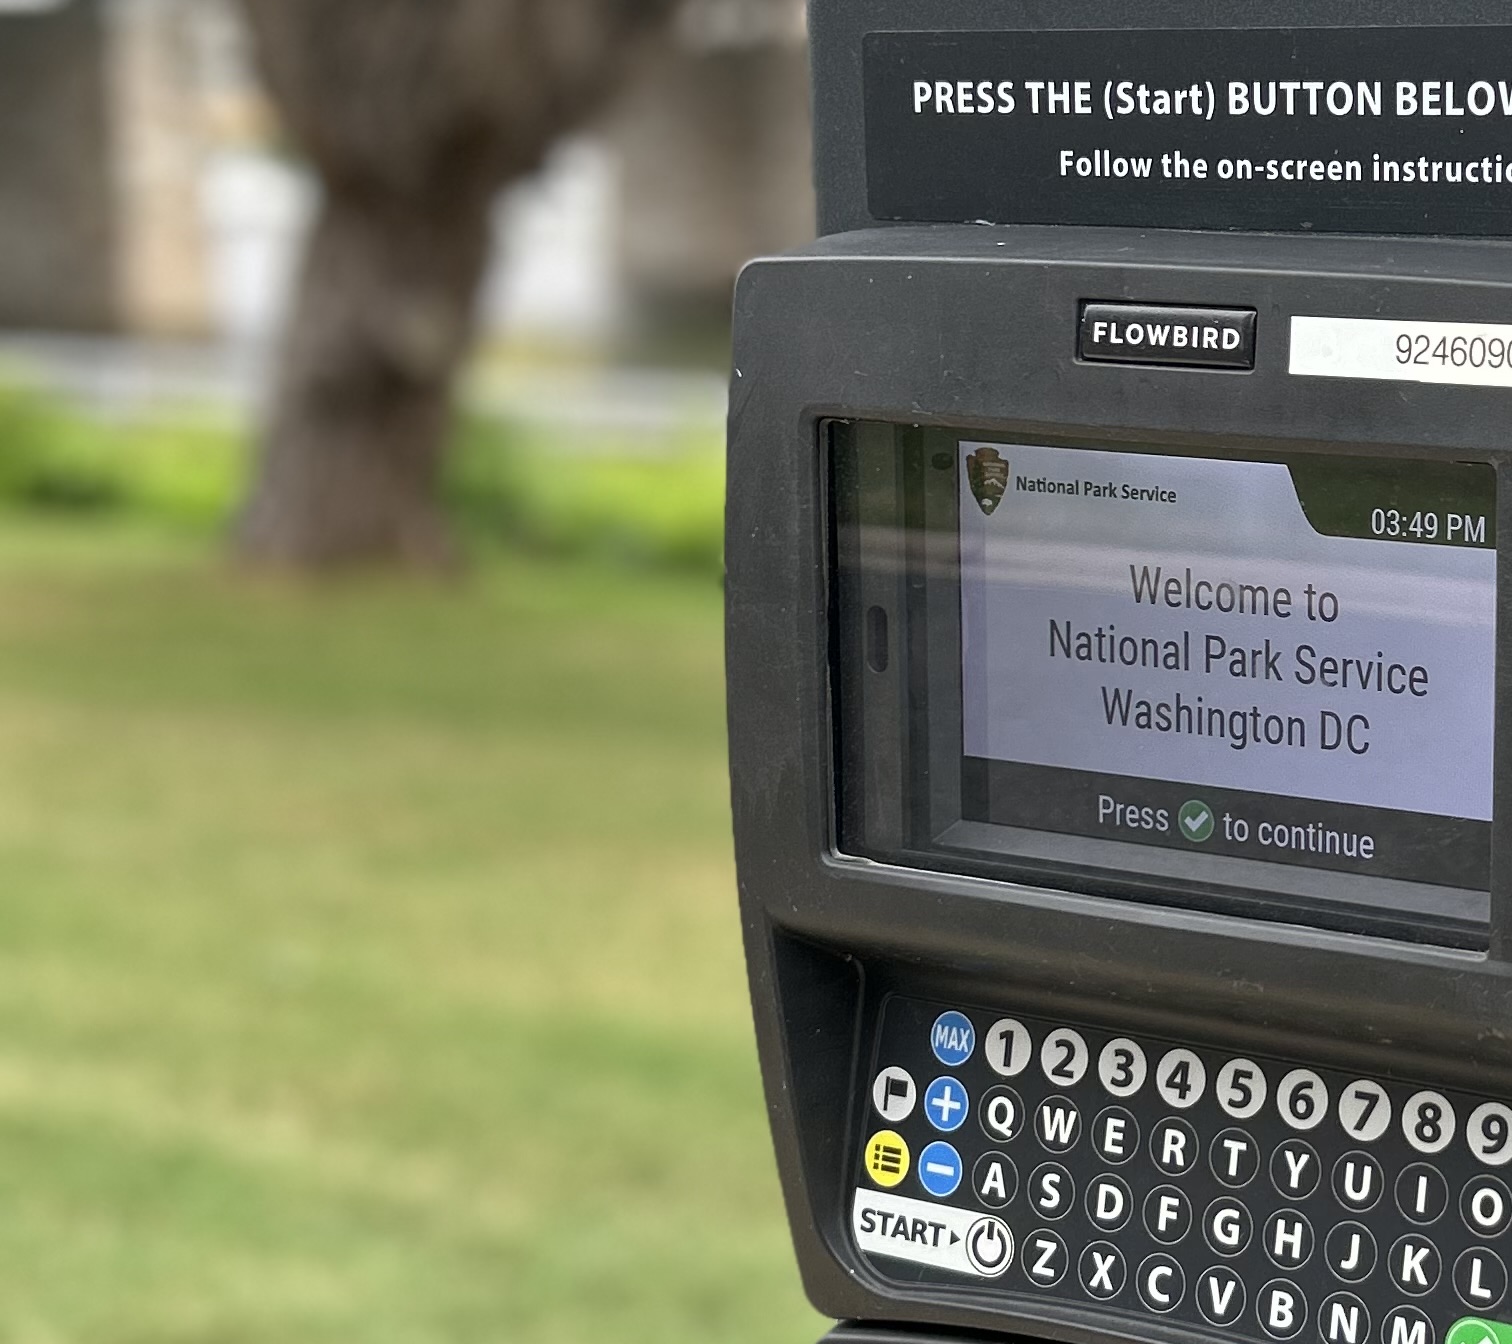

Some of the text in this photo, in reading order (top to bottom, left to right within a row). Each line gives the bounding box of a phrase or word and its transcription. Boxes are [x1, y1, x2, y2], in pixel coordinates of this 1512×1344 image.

[914, 82, 1014, 113] PRESS
[1025, 82, 1091, 113] THE
[1105, 81, 1214, 120] (Start)
[1229, 82, 1381, 115] BUTTON
[1061, 150, 1152, 177] Follow
[1161, 151, 1207, 178] the
[1218, 160, 1361, 180] on-screen
[1094, 321, 1239, 349] FLOWBIRD
[1017, 476, 1176, 503] National Park Service
[1371, 508, 1484, 542] 03:49 PM
[1129, 563, 1338, 622] Welcome to
[1050, 620, 1428, 696] National Park Service
[1101, 686, 1369, 754] Washington DC
[1099, 795, 1374, 858] Press to continue
[935, 1024, 971, 1052] MAX
[1000, 1030, 1014, 1067] 1
[1052, 1038, 1076, 1078] 2
[1111, 1048, 1134, 1087] 3
[1165, 1060, 1192, 1100] 4
[1227, 1069, 1254, 1108] 5
[1288, 1081, 1315, 1121] 6
[1354, 1091, 1380, 1132] 7
[1415, 1102, 1442, 1144] 8
[1481, 1113, 1509, 1154] 9
[988, 1097, 1015, 1137] Q
[1042, 1106, 1076, 1144] W
[1104, 1118, 1126, 1155] E
[1162, 1129, 1186, 1166] R
[1223, 1140, 1247, 1177] T
[1285, 1151, 1309, 1188] Y
[1344, 1162, 1373, 1201] U
[1416, 1176, 1427, 1212] I
[1472, 1188, 1503, 1226] O
[860, 1208, 946, 1247] START
[981, 1162, 1007, 1199] A
[1040, 1173, 1061, 1208] S
[1096, 1183, 1123, 1219] D
[1158, 1196, 1180, 1233] F
[1213, 1209, 1239, 1245] G
[1274, 1218, 1303, 1259] H
[1340, 1233, 1361, 1270] J
[1402, 1244, 1430, 1285] K
[1470, 1258, 1492, 1298] L
[1032, 1240, 1057, 1277] Z
[1089, 1251, 1115, 1291] X
[1148, 1266, 1172, 1302] C
[1209, 1276, 1236, 1315] V
[1269, 1291, 1294, 1328] B
[1330, 1303, 1359, 1344] N
